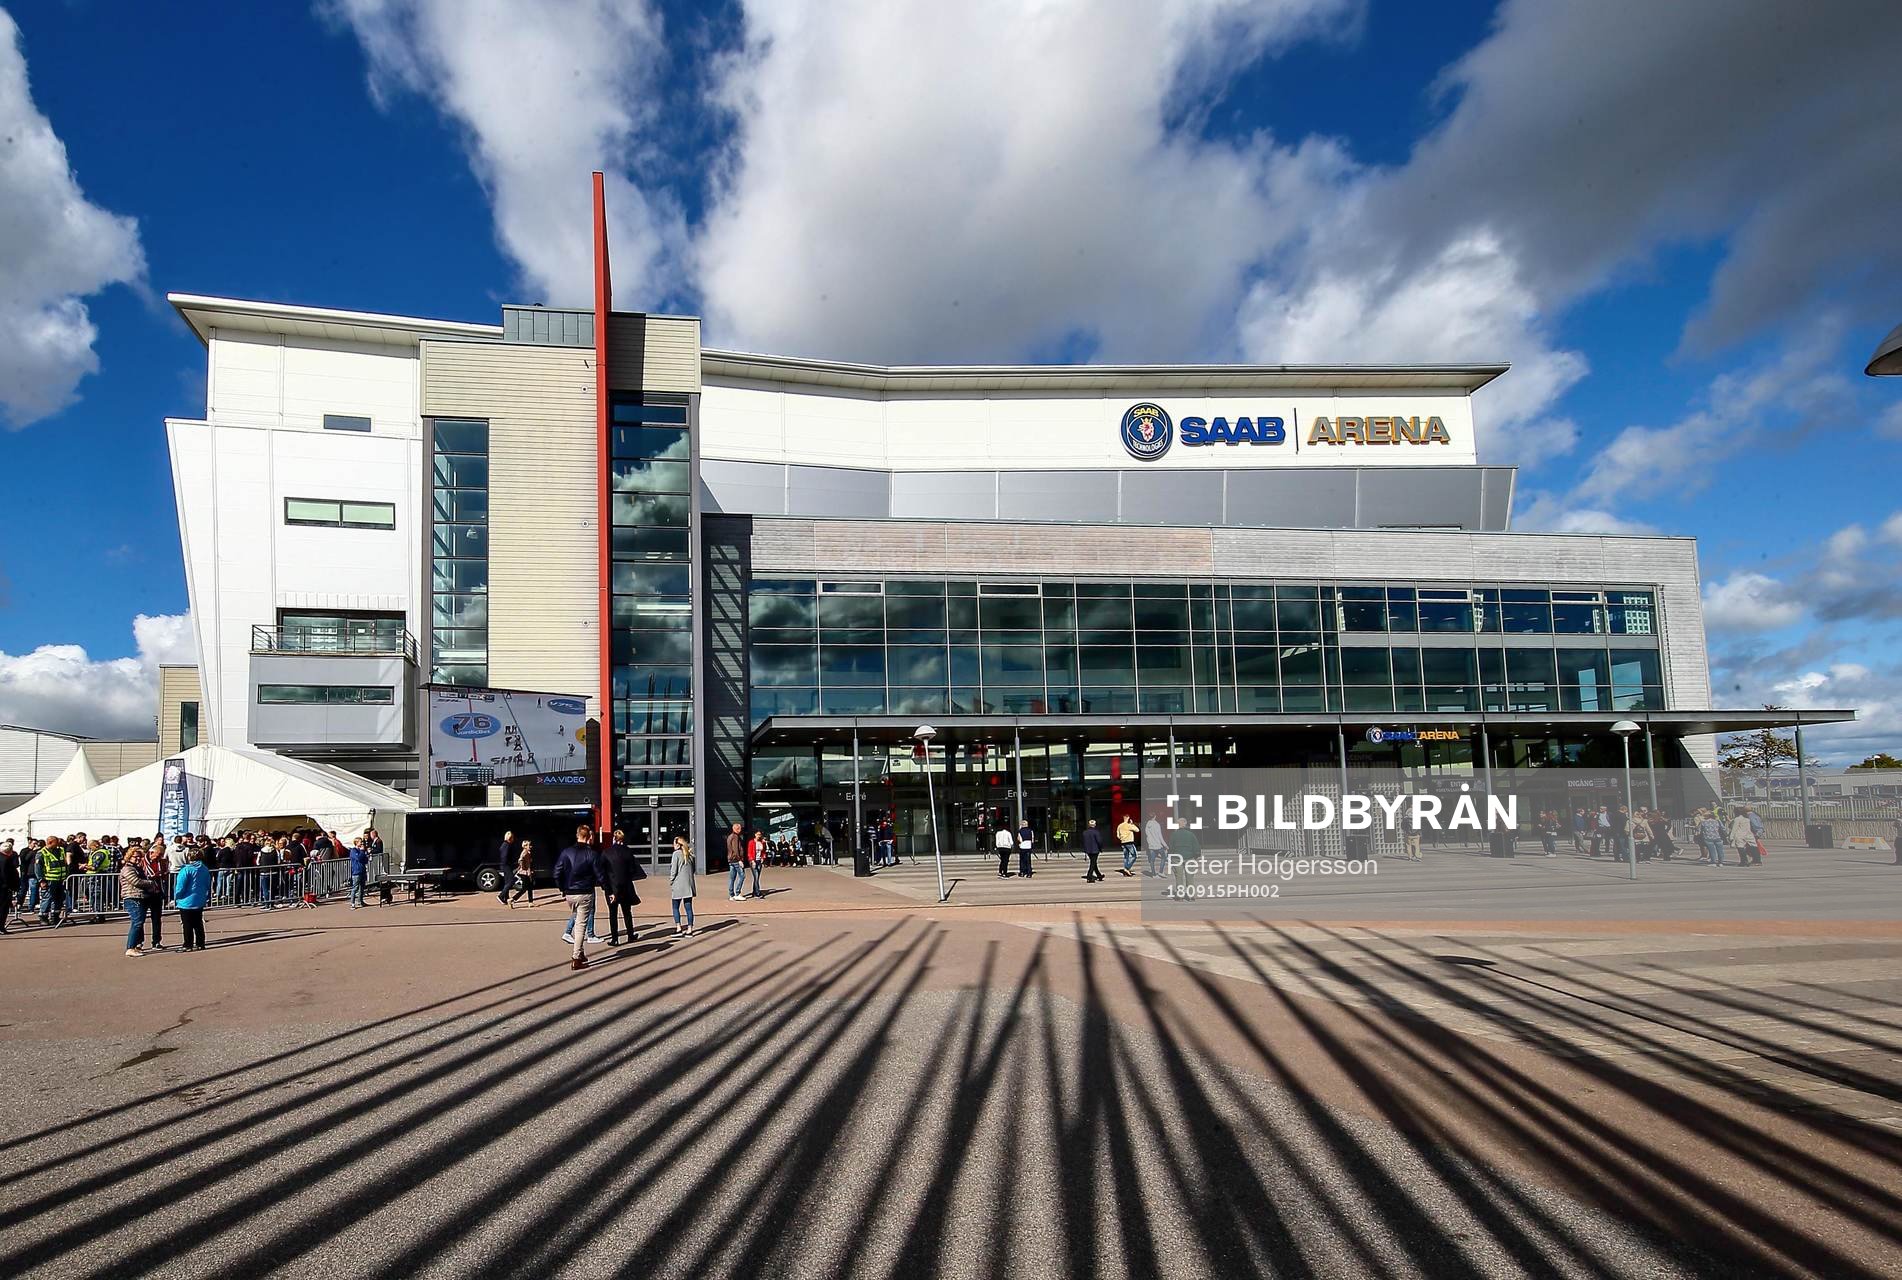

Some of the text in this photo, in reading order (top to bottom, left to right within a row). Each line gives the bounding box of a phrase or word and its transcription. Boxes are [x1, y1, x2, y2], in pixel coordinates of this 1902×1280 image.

[1133, 407, 1159, 417] SAAB
[1180, 416, 1451, 446] SAAB ARENA
[453, 715, 492, 730] 76
[1420, 731, 1460, 740] ARENA
